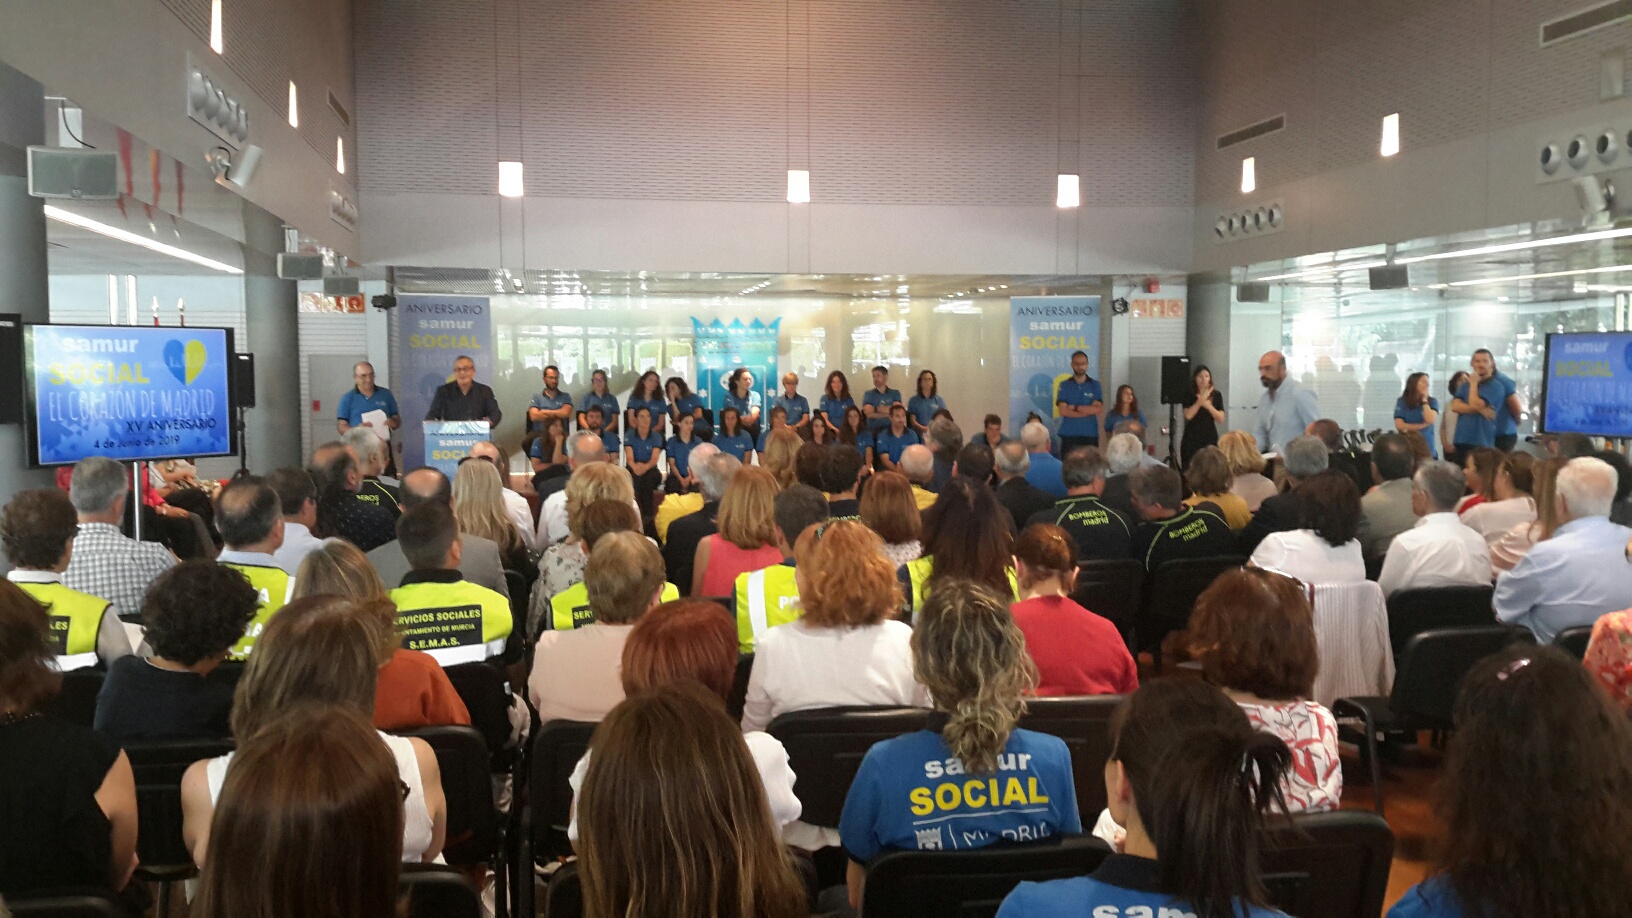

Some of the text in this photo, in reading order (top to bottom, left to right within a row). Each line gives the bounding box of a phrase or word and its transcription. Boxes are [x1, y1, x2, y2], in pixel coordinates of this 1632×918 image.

[405, 303, 483, 315] ANIVERSARIO
[1017, 305, 1093, 316] ANIVERSARIO
[418, 319, 474, 329] samur
[1030, 321, 1084, 331] samur
[62, 338, 139, 353] samur
[409, 334, 481, 349] SOCIAL
[1019, 336, 1090, 350] SOCIAL
[1564, 342, 1609, 353] samur
[50, 362, 150, 385] SOCIAL
[1556, 360, 1614, 377] SOCIAL
[49, 391, 63, 421] EL
[141, 389, 157, 418] DE
[161, 389, 215, 419] MADRID
[126, 418, 217, 432] XV ANIVERSARIO
[94, 440, 100, 448] 4
[104, 438, 115, 448] de
[144, 436, 155, 446] de
[159, 435, 180, 446] 2019
[432, 450, 468, 460] SOCI
[437, 609, 480, 621] SOCIALES
[442, 625, 450, 633] DE
[452, 623, 475, 631] MURCIA
[409, 637, 460, 649] S.E.M.A.S.
[924, 753, 1031, 779] saur
[910, 776, 1049, 816] SOCIAL
